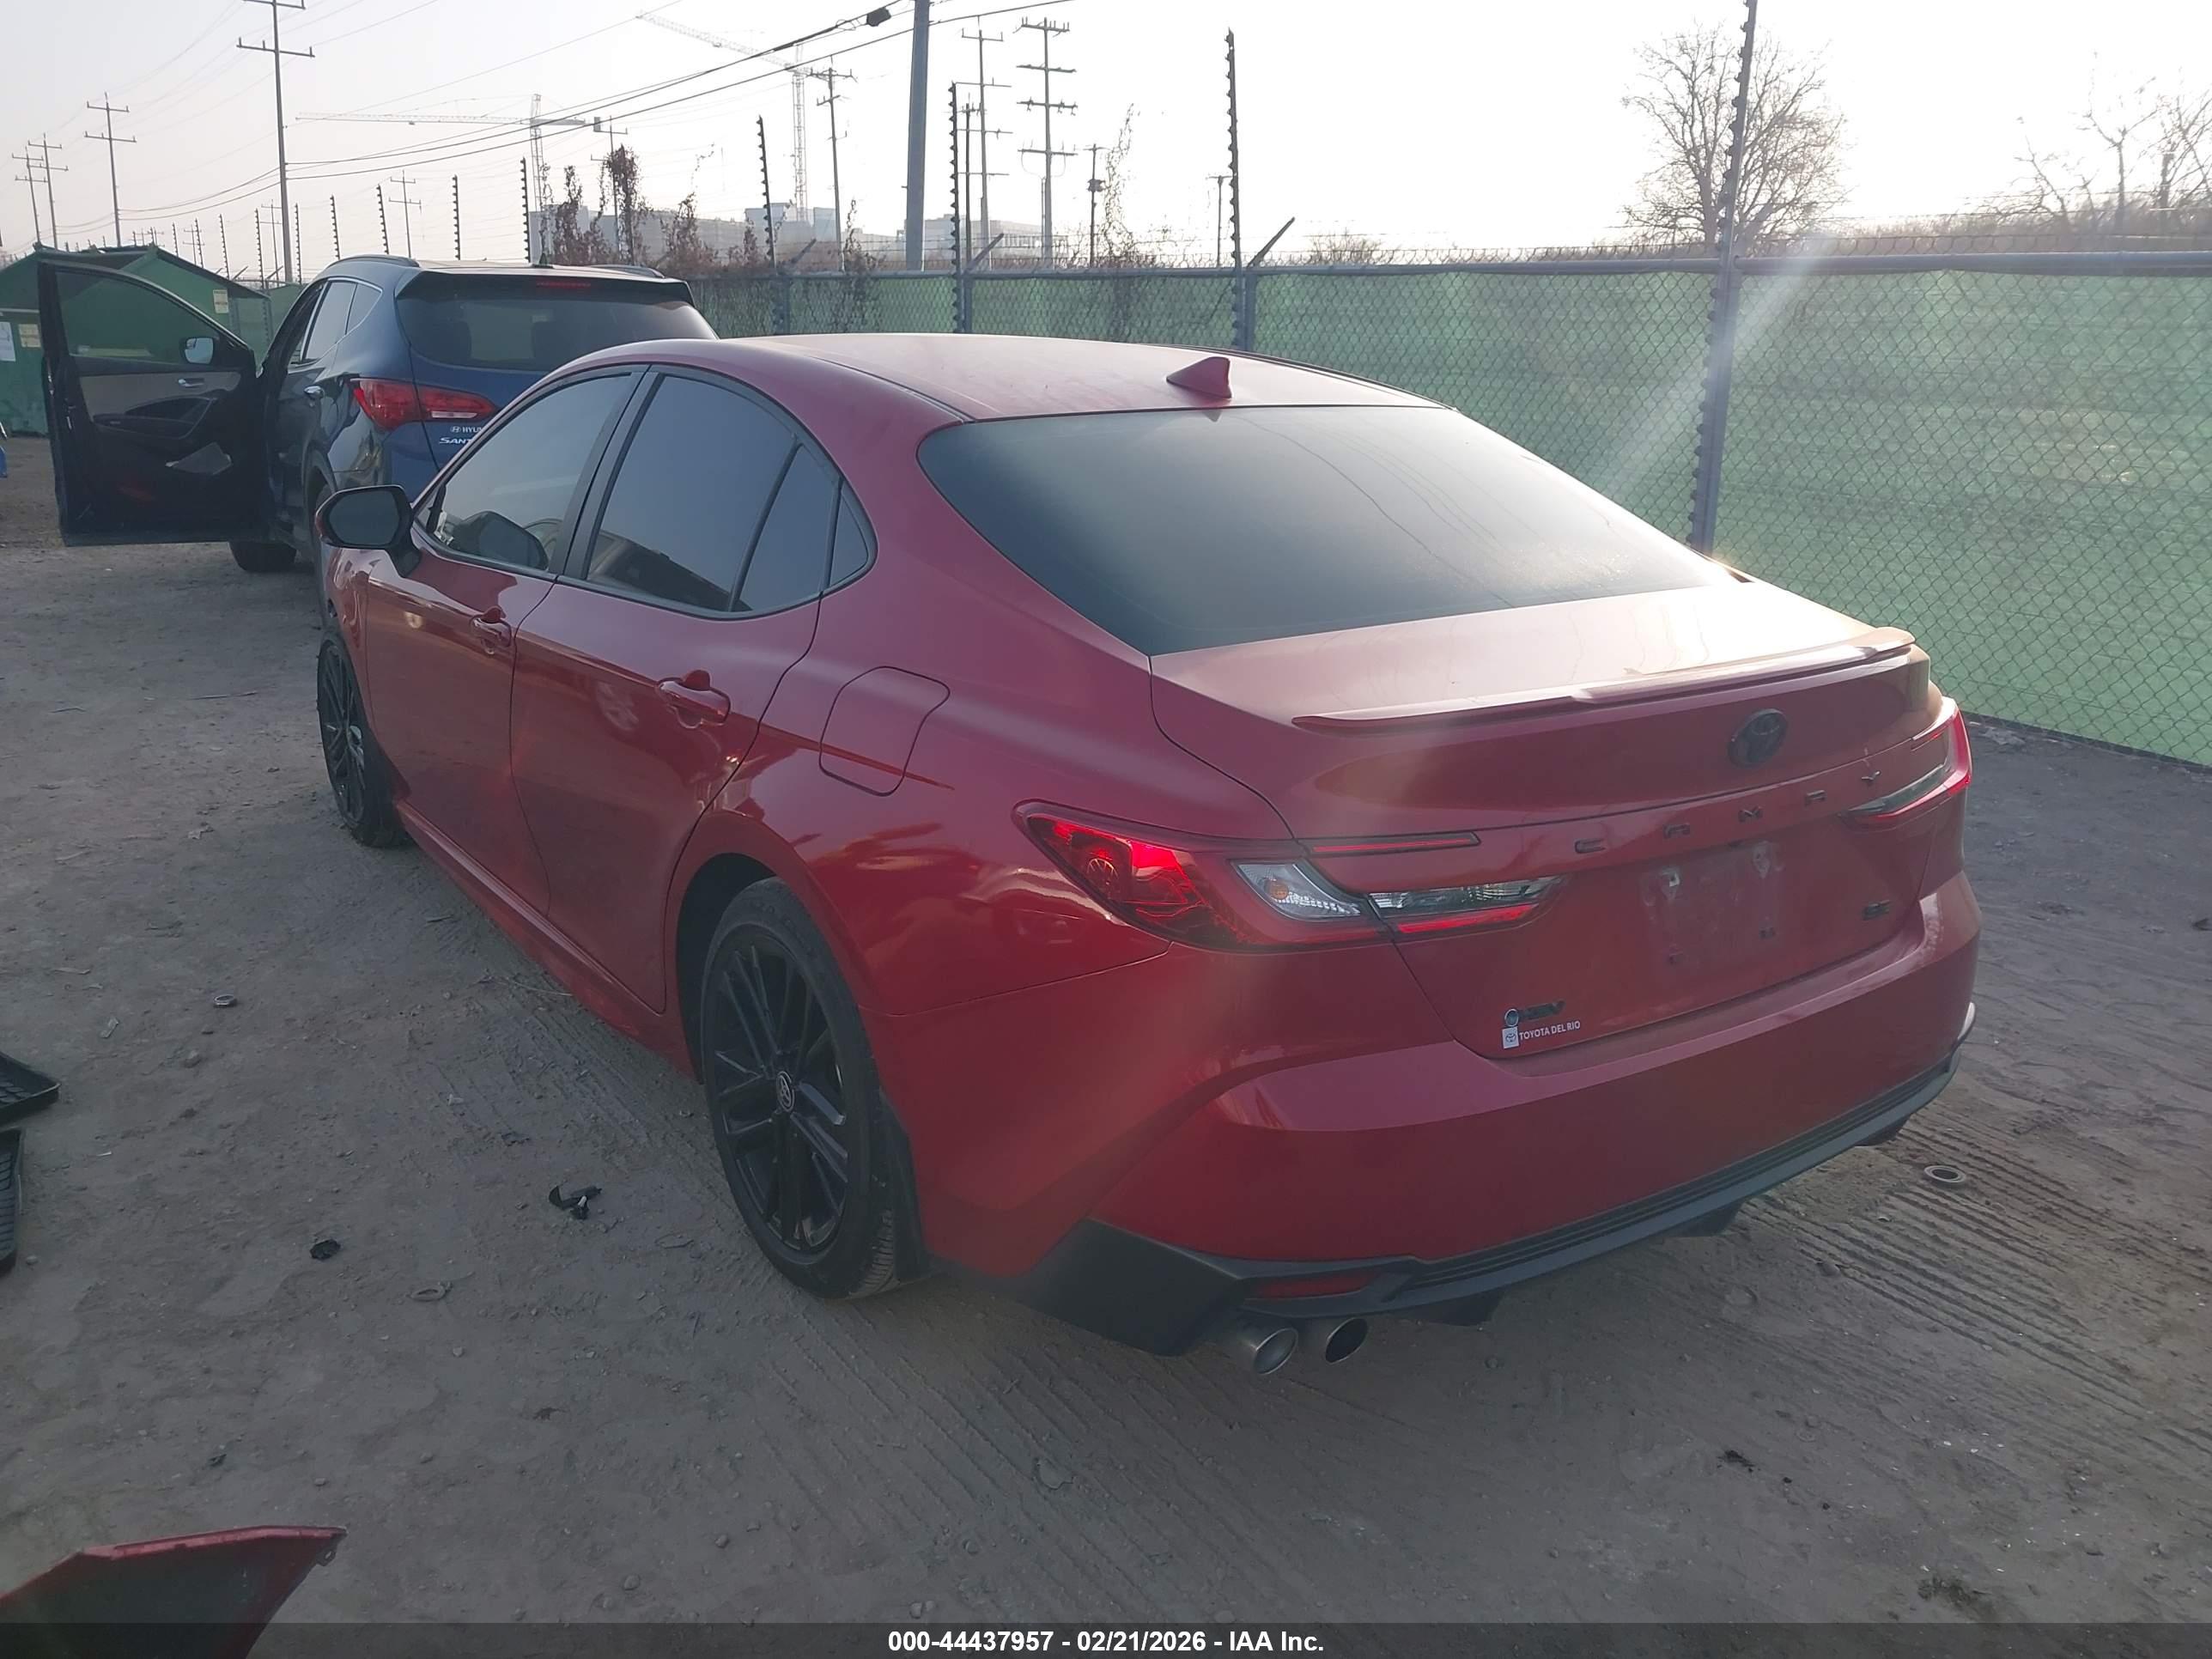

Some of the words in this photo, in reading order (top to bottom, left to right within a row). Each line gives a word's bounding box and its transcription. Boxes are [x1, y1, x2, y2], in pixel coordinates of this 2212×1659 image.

[1519, 1027, 1550, 1041] TOYOTA
[1551, 1024, 1566, 1034] DEL
[1567, 1020, 1581, 1030] RIO
